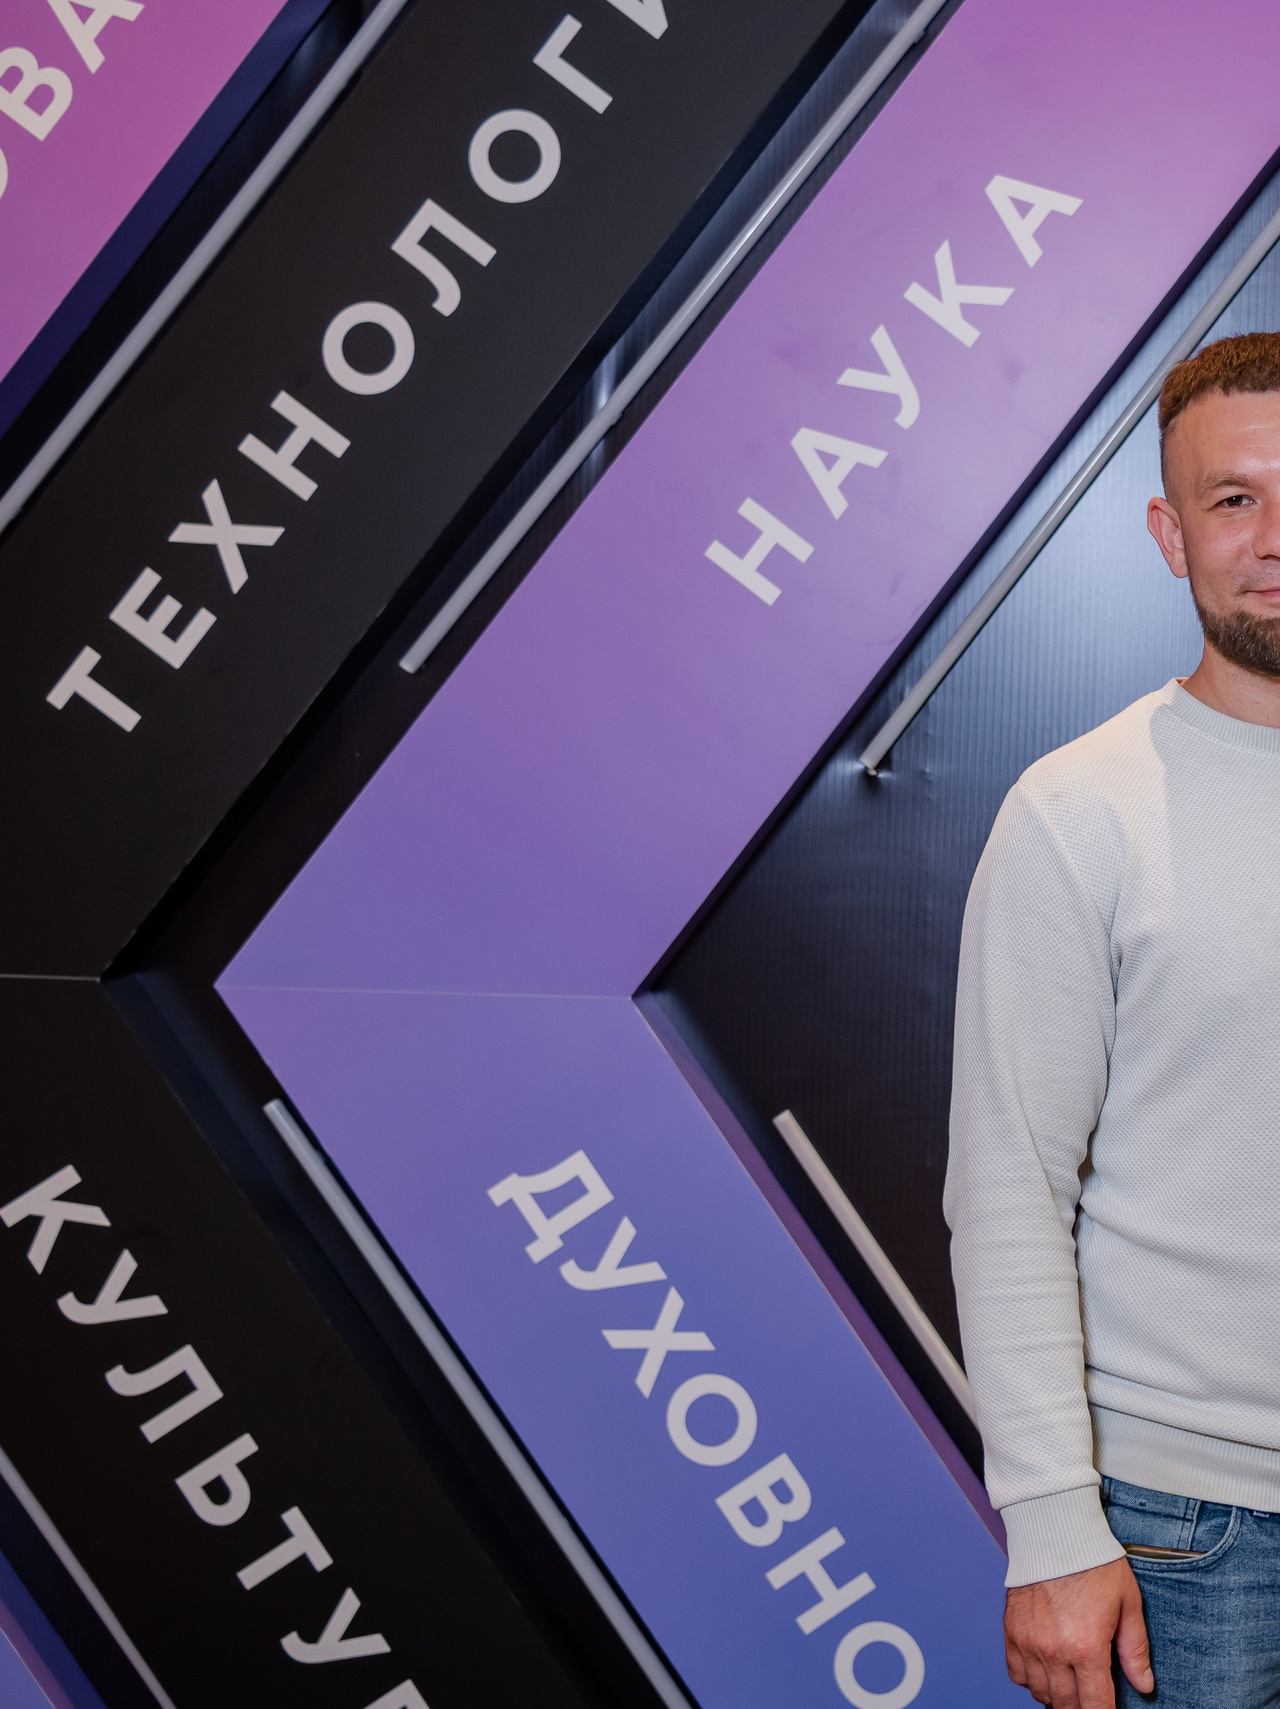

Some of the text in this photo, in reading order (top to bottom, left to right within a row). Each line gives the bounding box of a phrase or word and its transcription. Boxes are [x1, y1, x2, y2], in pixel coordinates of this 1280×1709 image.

[0, 0, 145, 199] ВА
[703, 174, 1084, 607] НАУКА
[486, 1149, 926, 1709] ДУХОВНО
